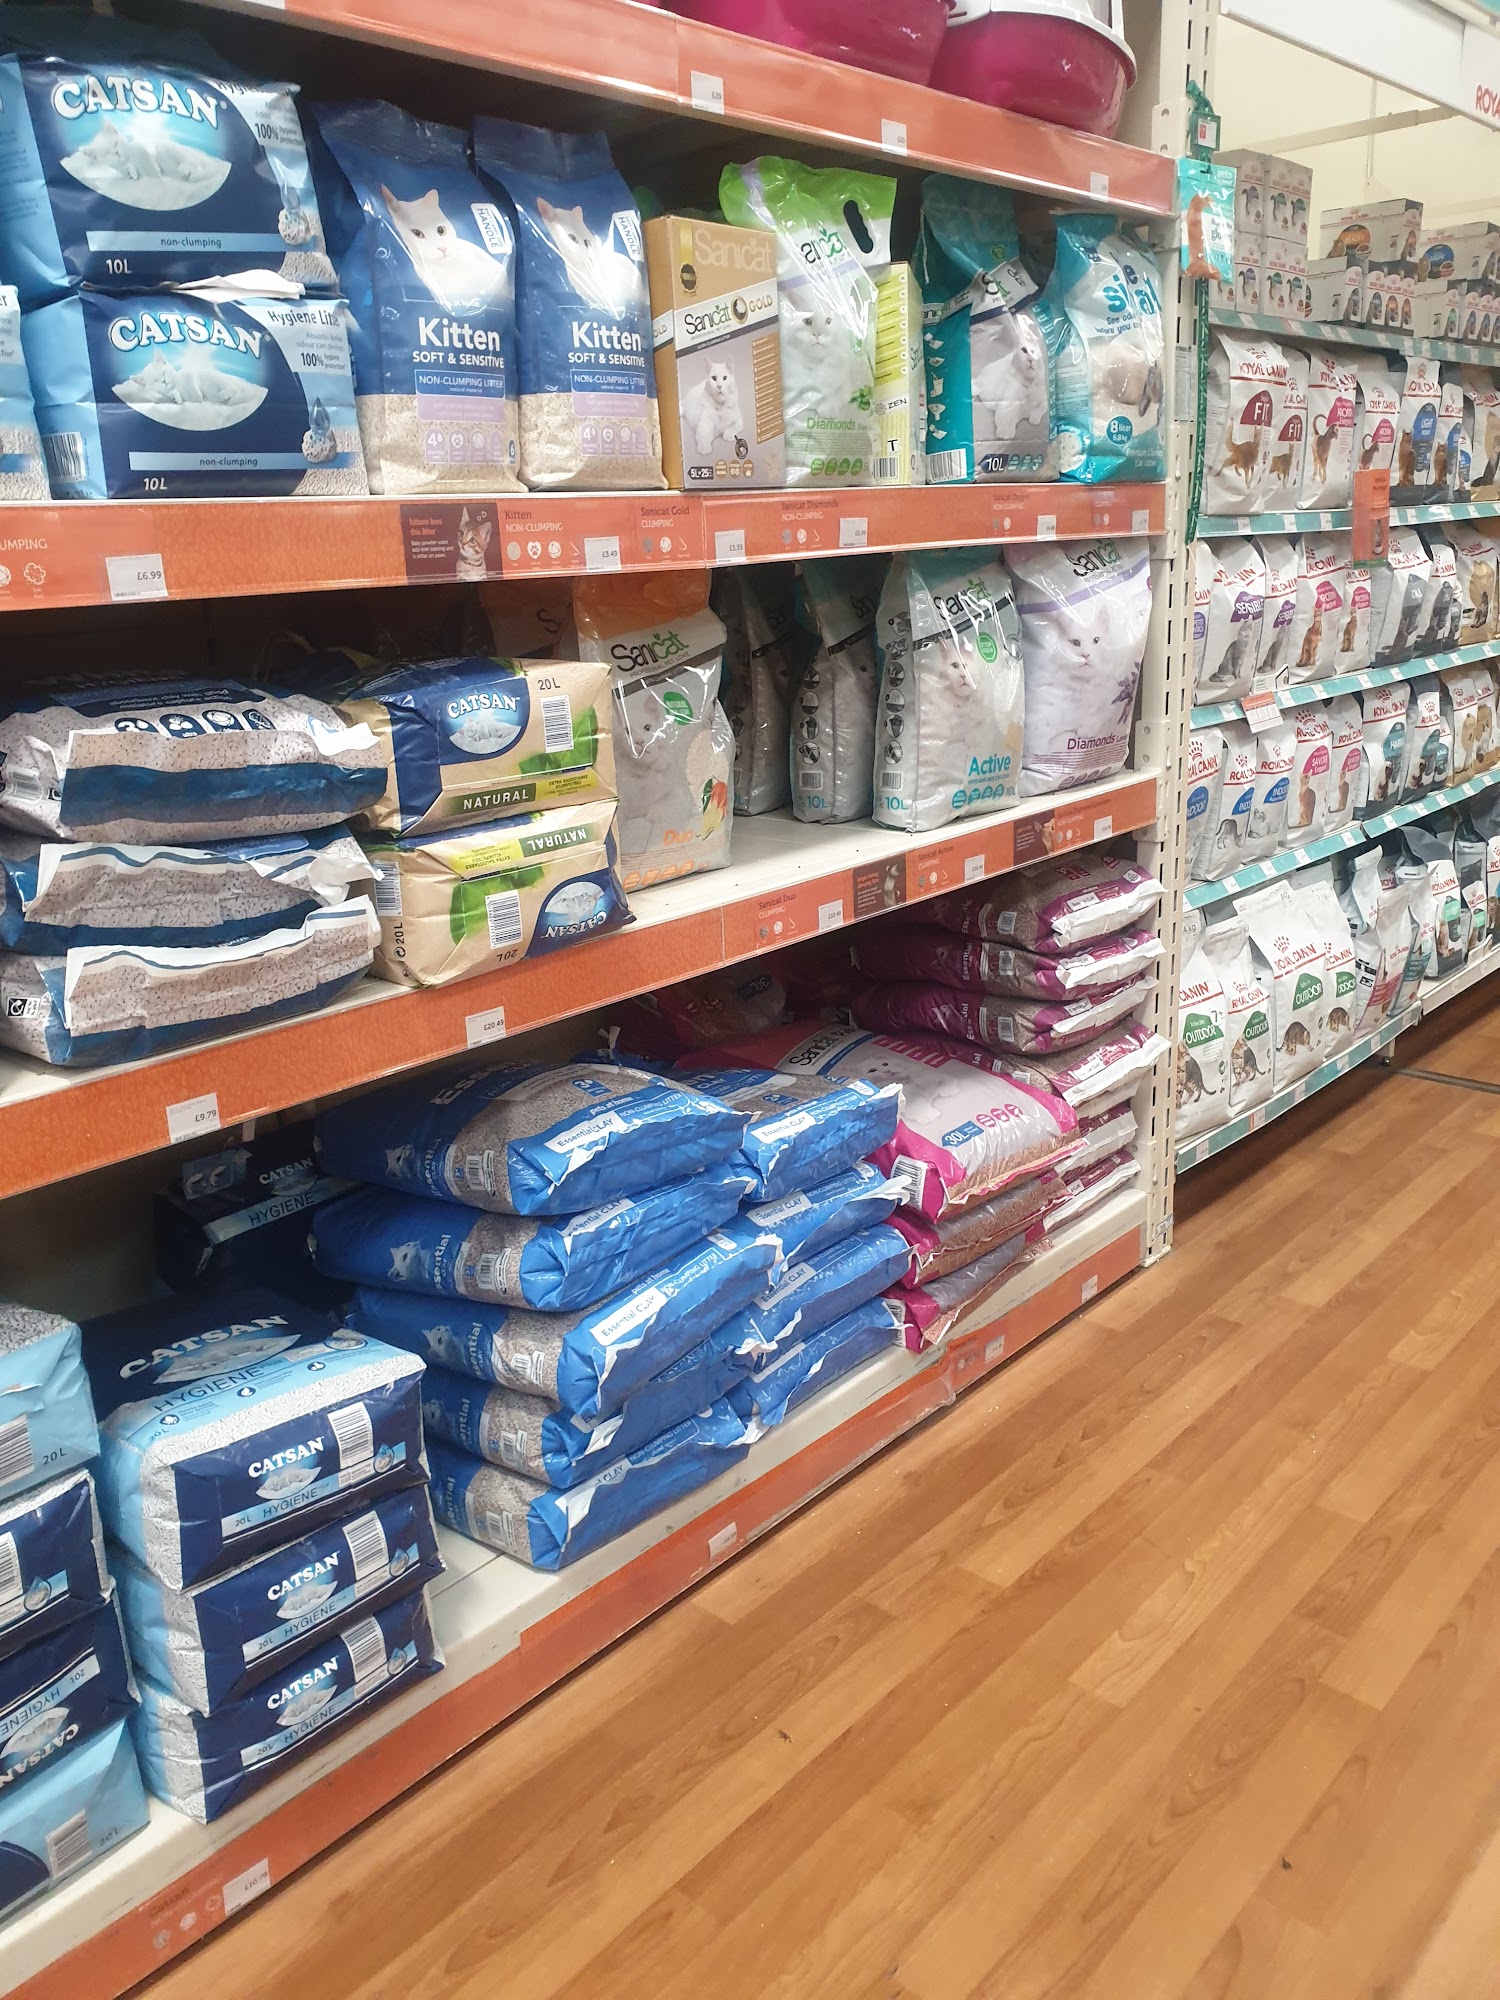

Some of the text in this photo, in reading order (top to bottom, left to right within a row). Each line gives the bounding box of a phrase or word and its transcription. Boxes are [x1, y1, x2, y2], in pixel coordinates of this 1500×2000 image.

[52, 75, 219, 129] CATSAN
[255, 122, 279, 140] 100%
[477, 208, 499, 248] HANDLE
[160, 236, 222, 249] non-clumping
[695, 229, 773, 274] Sanicat
[106, 258, 132, 275] 10L
[267, 309, 317, 327] Hygiene
[684, 294, 773, 335] Sanicat GOLD
[1106, 316, 1120, 325] See
[110, 312, 262, 358] CATSAN
[418, 317, 501, 352] Kitten
[572, 321, 642, 352] Kitten
[1117, 324, 1131, 335] you
[301, 352, 325, 367] 100%
[413, 351, 505, 369] SOFT & SENSITIVE
[568, 352, 646, 368] SOFT & SENSITIVE
[419, 375, 504, 389] NON-CLUMPING LITTER
[574, 373, 631, 385] NON-CLUMPING
[887, 397, 907, 409] ZEN
[1253, 402, 1270, 421] FIT
[806, 417, 856, 431] Diamonds
[1110, 421, 1118, 433] 8
[1288, 424, 1302, 438] FIT
[199, 457, 258, 468] non-clumping
[986, 456, 1004, 471] 10L
[143, 478, 168, 491] 10L
[640, 505, 690, 516] Sanicat Gold
[806, 500, 839, 509] Diamonds
[504, 510, 533, 520] Kitten
[641, 519, 675, 528] CLUMPING
[505, 522, 563, 533] NON-CLUMPING
[137, 570, 162, 581] £6.99
[611, 630, 691, 672] Sanicat
[447, 694, 517, 719] CATSAN
[1066, 733, 1116, 751] Diamonds
[968, 753, 1011, 777] Active
[463, 789, 529, 810] NATURAL
[806, 796, 829, 809] 10L
[885, 797, 909, 811] 10L
[527, 828, 587, 851] NATURAL
[664, 827, 693, 844] Duo
[758, 893, 797, 910] Sanicat Duo
[396, 922, 404, 944] 20L
[545, 911, 607, 939] CATSAN
[496, 949, 519, 962] 20L
[1179, 980, 1209, 1003] CANIN
[1295, 984, 1323, 1006] OUTDOOR
[1185, 1024, 1217, 1044] OUTDOOR
[662, 1092, 683, 1106] LITTER
[195, 1109, 217, 1122] £9.79
[589, 1104, 604, 1116] pets
[605, 1101, 613, 1109] at
[790, 1116, 807, 1127] CLAY
[557, 1118, 614, 1147] Essential CLAY
[944, 1131, 968, 1146] 30L
[258, 1157, 313, 1185] CATSAN
[249, 1193, 315, 1227] HYGIENE
[600, 1199, 623, 1217] CLAY
[755, 1198, 803, 1221] Essential CLAY
[698, 1252, 718, 1270] LITTER
[787, 1267, 807, 1284] CLAY
[631, 1283, 644, 1295] pets
[602, 1310, 636, 1337] Essential
[119, 1314, 289, 1379] CATSAN
[154, 1364, 265, 1413] HYGIENE
[42, 1447, 67, 1466] 20L
[248, 1436, 325, 1479] CATSAN
[235, 1487, 319, 1528] 20L HYGIENE
[267, 1551, 341, 1602] CATSAN
[258, 1602, 337, 1651] 20L HYGIENE
[267, 1656, 341, 1711] CATSAN
[0, 1668, 86, 1737] 20L HYGIENE
[257, 1704, 337, 1756] 20L HYGIENE
